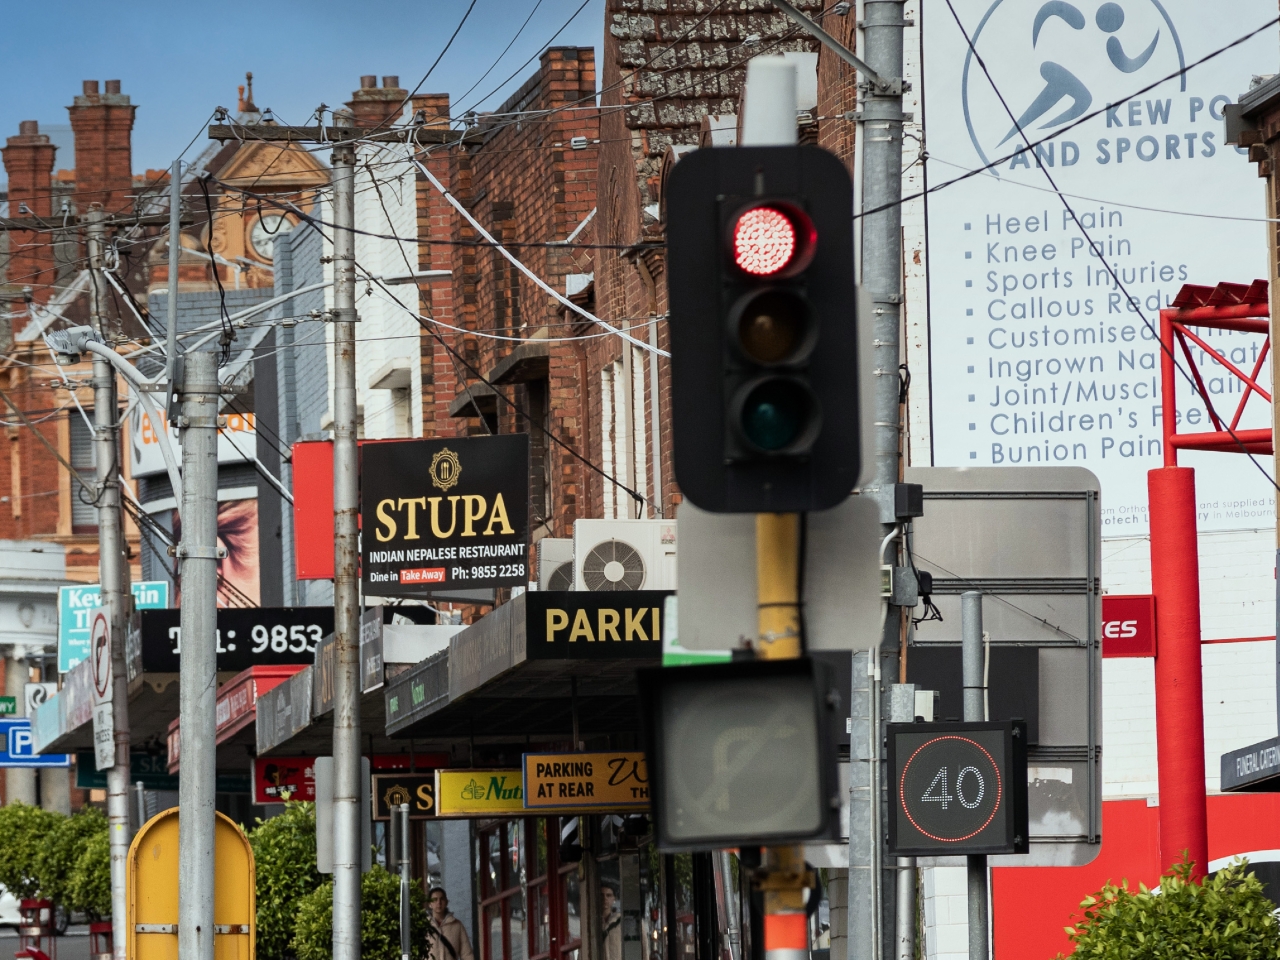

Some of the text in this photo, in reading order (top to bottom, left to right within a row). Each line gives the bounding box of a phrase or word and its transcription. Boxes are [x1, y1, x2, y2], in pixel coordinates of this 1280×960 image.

[1106, 93, 1233, 129] KEW PO
[1009, 131, 1216, 170] AND SPORTS
[985, 206, 1123, 235] Heel Pain
[986, 235, 1131, 263] Knee Pain
[986, 262, 1188, 296] Sports Injuries
[987, 296, 1094, 321] Callous
[988, 319, 1156, 349] Customised
[989, 354, 1104, 381] Ingrown
[1118, 349, 1156, 371] Na
[989, 376, 1158, 407] Joint/Muscl
[990, 408, 1138, 435] Children's
[992, 435, 1162, 464] Bunion Pain
[375, 492, 515, 542] STUPA
[1213, 510, 1222, 519] in
[1222, 498, 1265, 509] supplied
[369, 543, 526, 564] INDIAN NEPALESE RESTAURANT
[370, 563, 526, 583] Dine in Take Away Ph: 9855 2258
[251, 624, 323, 654] 9853
[545, 607, 661, 643] PARKI
[536, 761, 593, 778] PARKING
[486, 776, 523, 801] Nut
[537, 782, 594, 799] AT REAR
[921, 766, 985, 810] 40
